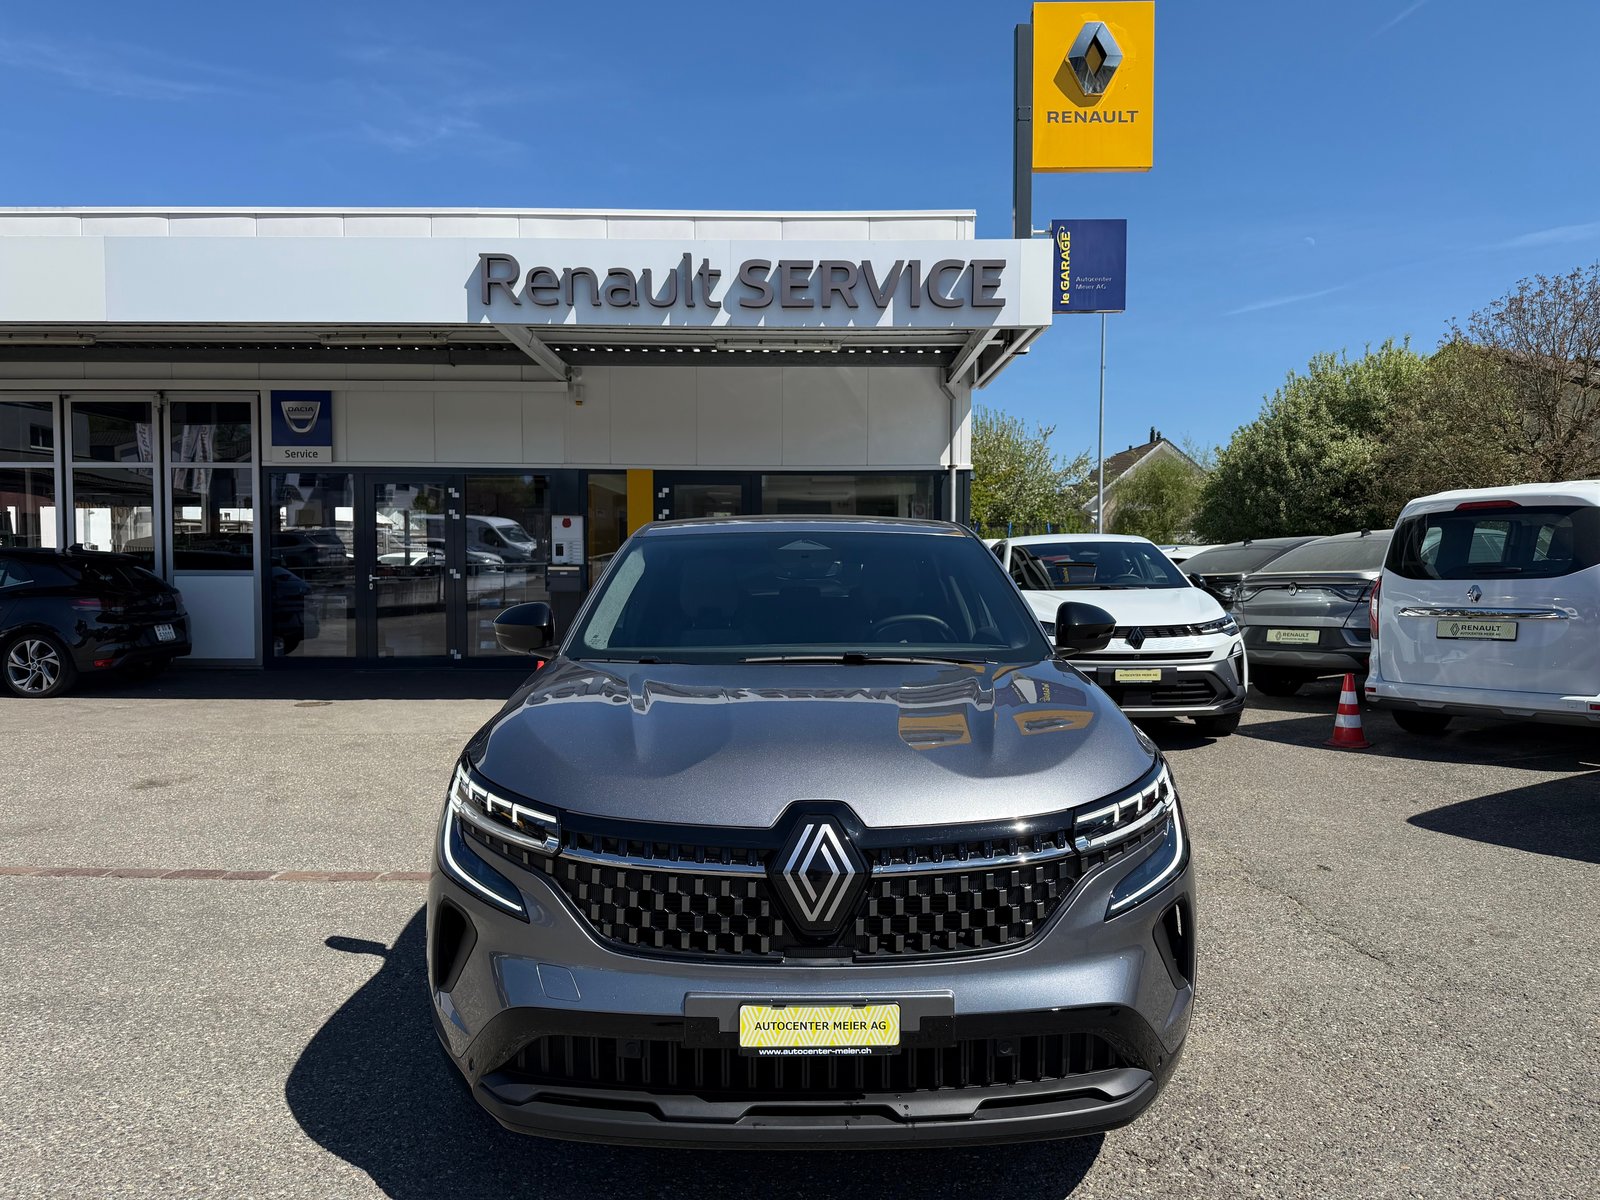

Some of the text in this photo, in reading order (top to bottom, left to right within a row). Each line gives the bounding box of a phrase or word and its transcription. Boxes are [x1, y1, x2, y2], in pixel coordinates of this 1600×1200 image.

[1046, 110, 1139, 124] RENAULT
[1060, 231, 1071, 305] le GARAGE
[478, 252, 1006, 309] Renault SERVICE
[284, 449, 319, 459] Service
[1460, 624, 1502, 632] RENAULT
[754, 1021, 887, 1031] AUTOCENTER MEIER AG
[758, 1047, 872, 1055] www.autocenter-meier.ch
